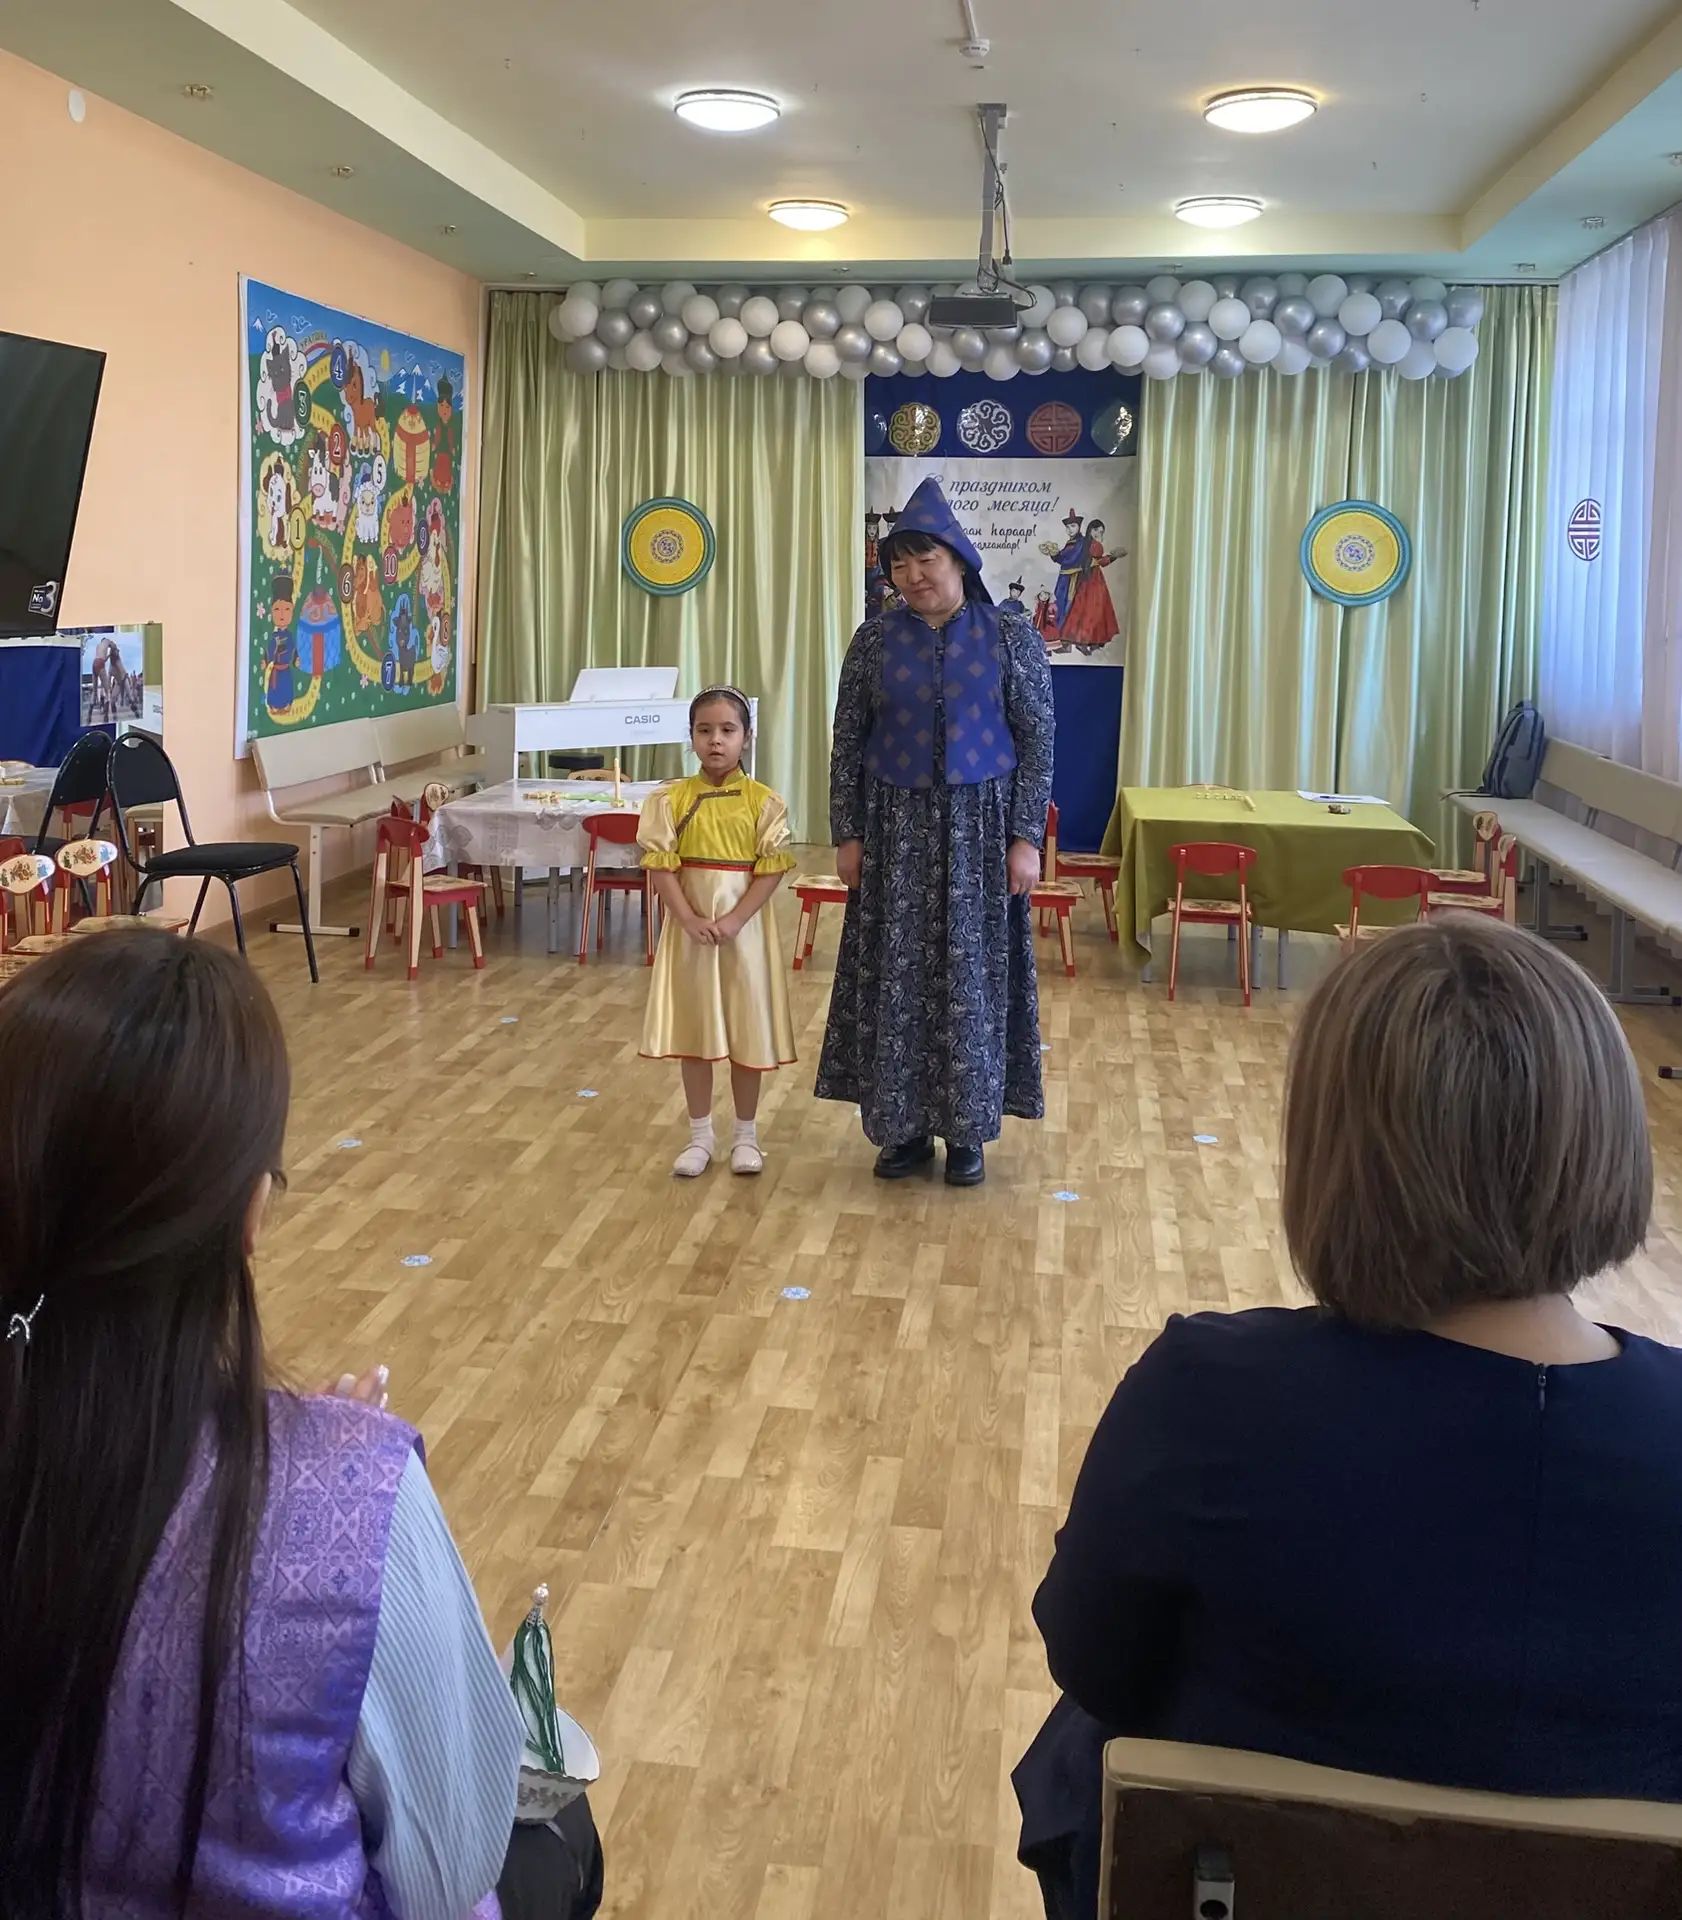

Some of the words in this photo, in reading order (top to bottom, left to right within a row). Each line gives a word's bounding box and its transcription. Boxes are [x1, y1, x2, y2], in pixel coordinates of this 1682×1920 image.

[333, 355, 343, 380] 4
[298, 390, 307, 417] 3
[332, 432, 341, 458] 2
[376, 463, 383, 484] 5
[949, 479, 1052, 496] праздником
[987, 496, 1060, 517] месяца!
[295, 517, 301, 540] 1
[419, 528, 427, 549] 9
[962, 527, 982, 536] аан
[384, 553, 397, 577] 10
[341, 572, 351, 597] 6
[41, 581, 57, 613] 3
[384, 661, 393, 684] 7
[624, 714, 661, 725] CASIO
